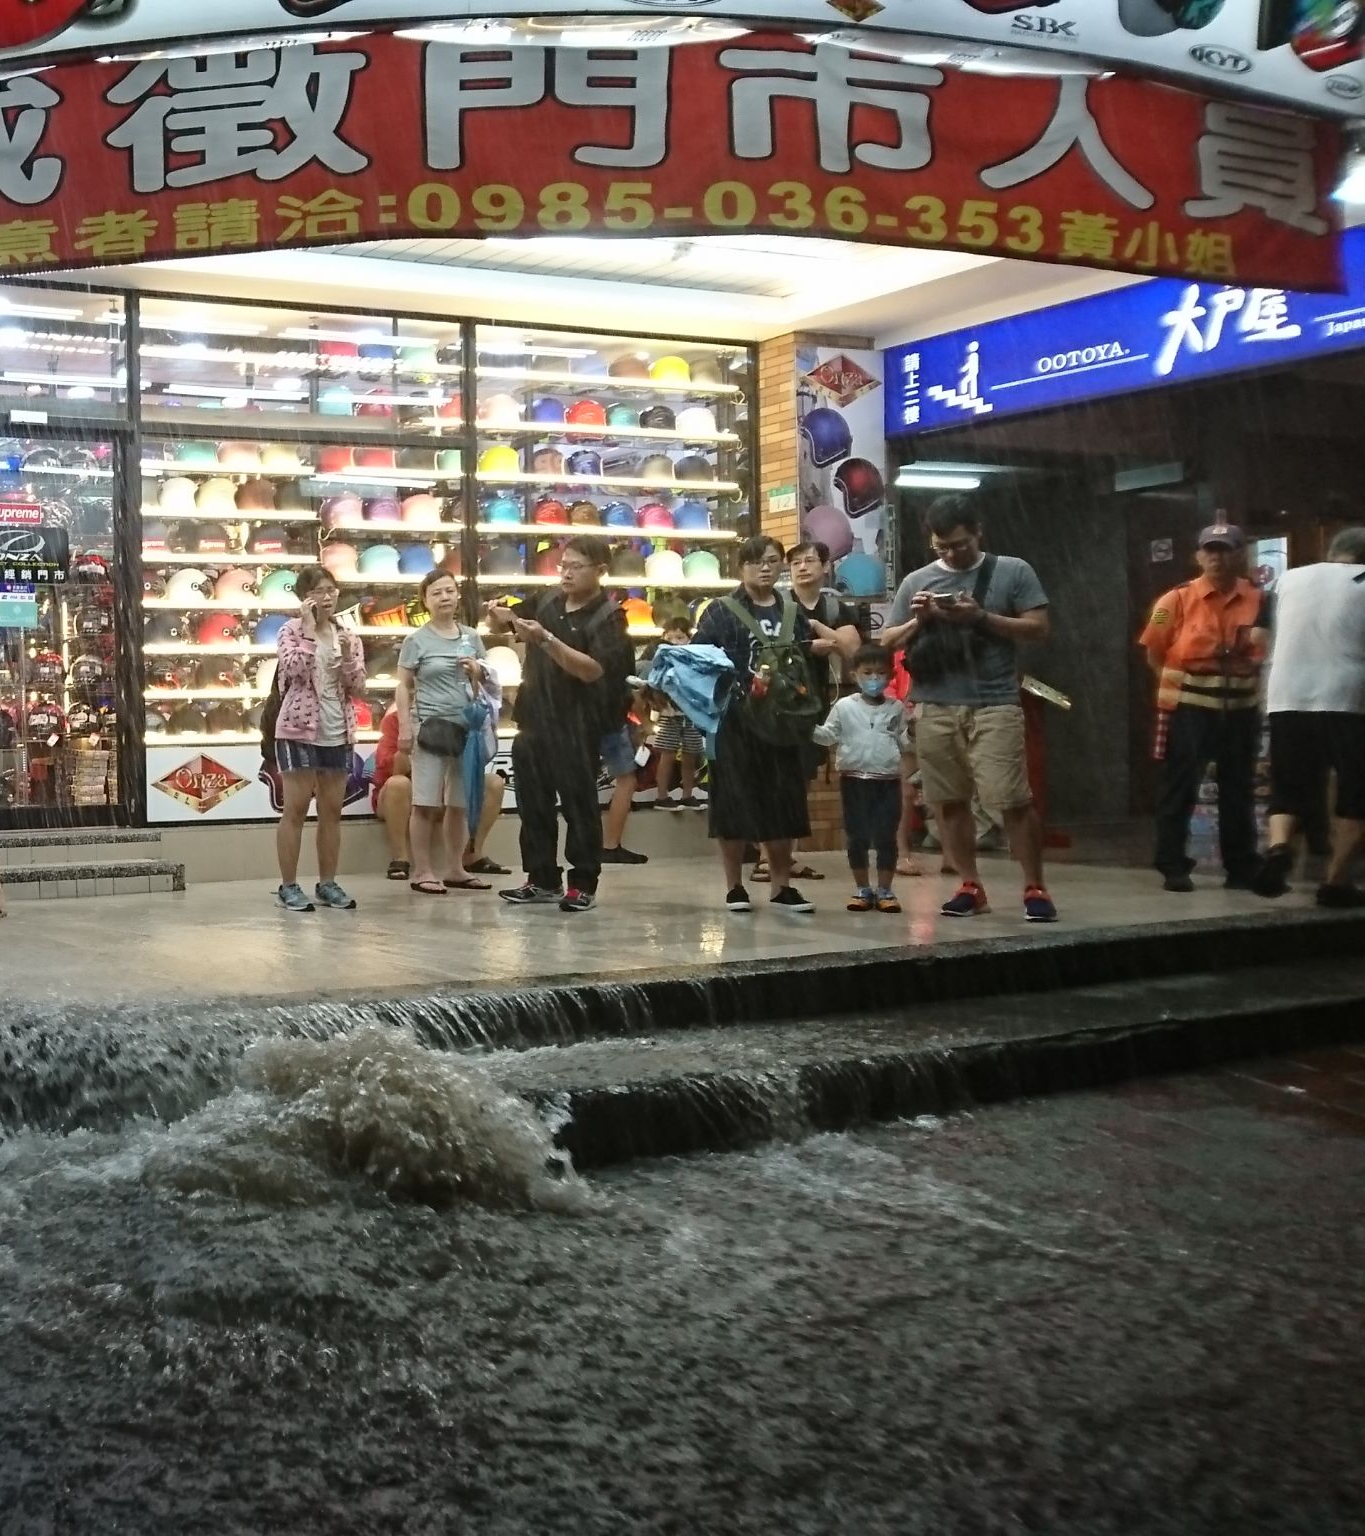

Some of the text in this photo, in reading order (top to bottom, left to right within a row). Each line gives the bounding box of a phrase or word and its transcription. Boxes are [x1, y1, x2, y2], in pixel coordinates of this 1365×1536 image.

[903, 352, 921, 425] 請上二樓
[175, 767, 229, 792] Onza
